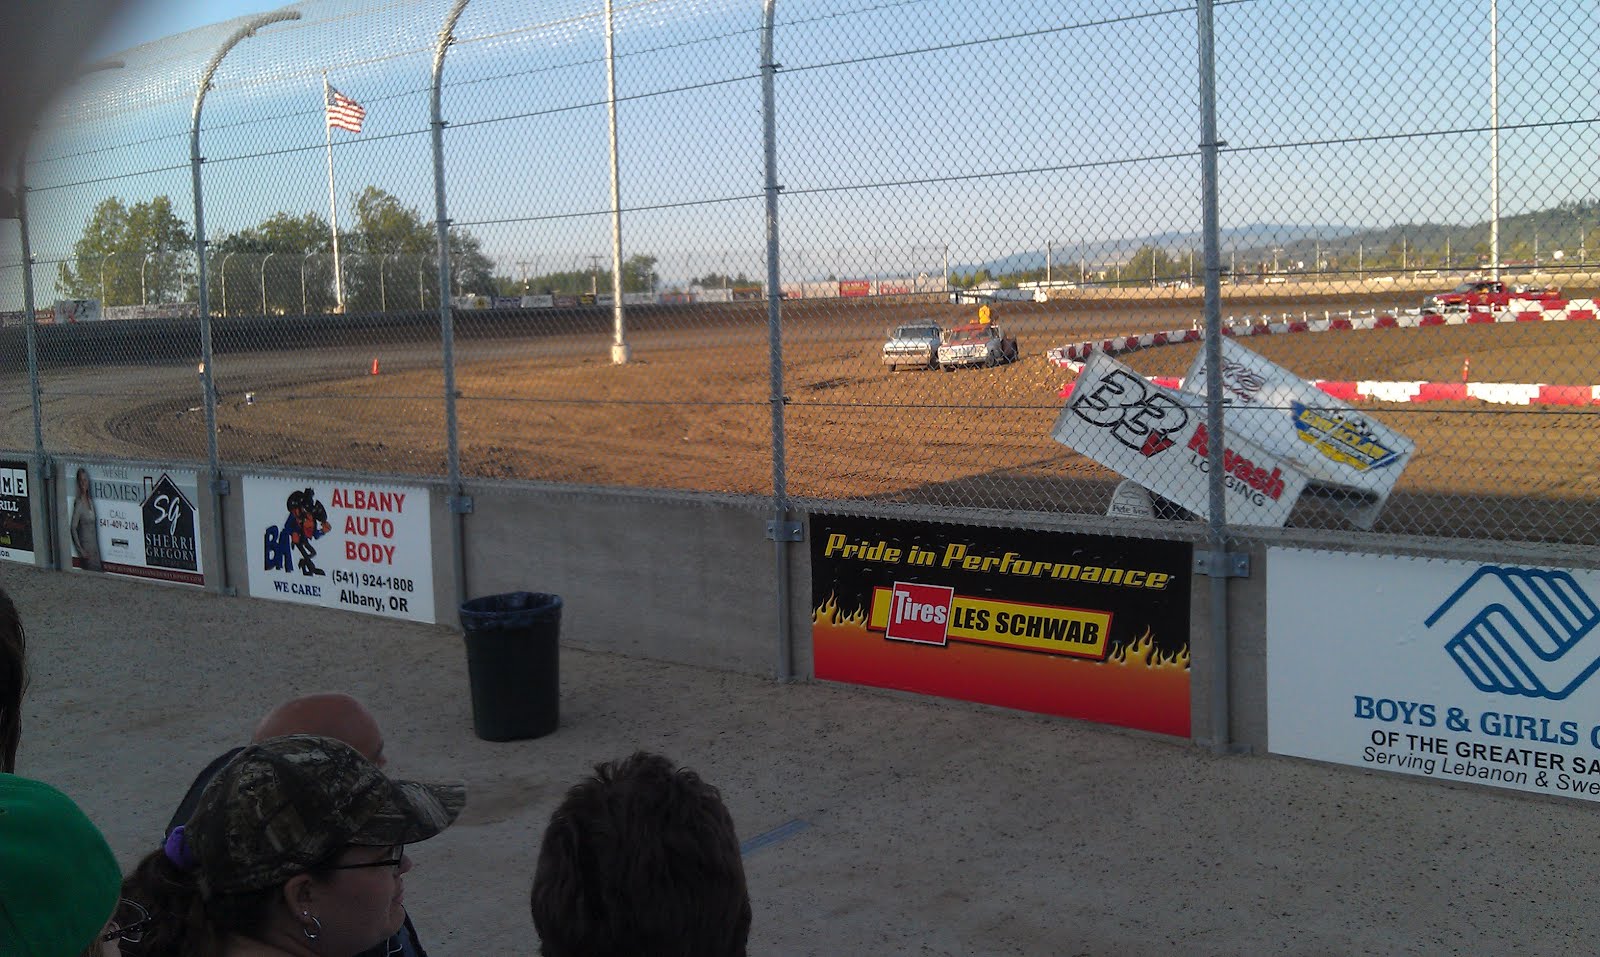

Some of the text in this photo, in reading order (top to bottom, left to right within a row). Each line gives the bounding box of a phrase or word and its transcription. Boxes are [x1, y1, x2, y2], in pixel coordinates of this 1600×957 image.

[94, 482, 141, 502] HOMES!
[1190, 454, 1266, 507] LOGING
[331, 488, 406, 513] ALBANY
[344, 515, 395, 539] AUTO
[146, 534, 195, 550] SHERRI
[146, 547, 195, 561] GREGORY
[345, 541, 396, 565] BODY
[824, 533, 1170, 590] Pride in Performance
[273, 580, 321, 598] WE CARE!
[332, 569, 414, 592] (541) 924-1808
[340, 589, 409, 613] Albany, OR
[895, 590, 948, 625] Tires
[953, 607, 1099, 645] LES SCHWAB
[1354, 695, 1437, 728] BOYS
[1446, 707, 1472, 733] &
[1480, 711, 1579, 746] GIRLS
[1371, 730, 1400, 747] OF
[1406, 734, 1448, 755] THE
[1455, 741, 1565, 771] GREATER
[1363, 746, 1600, 795] Serving Lebanon & Swe
